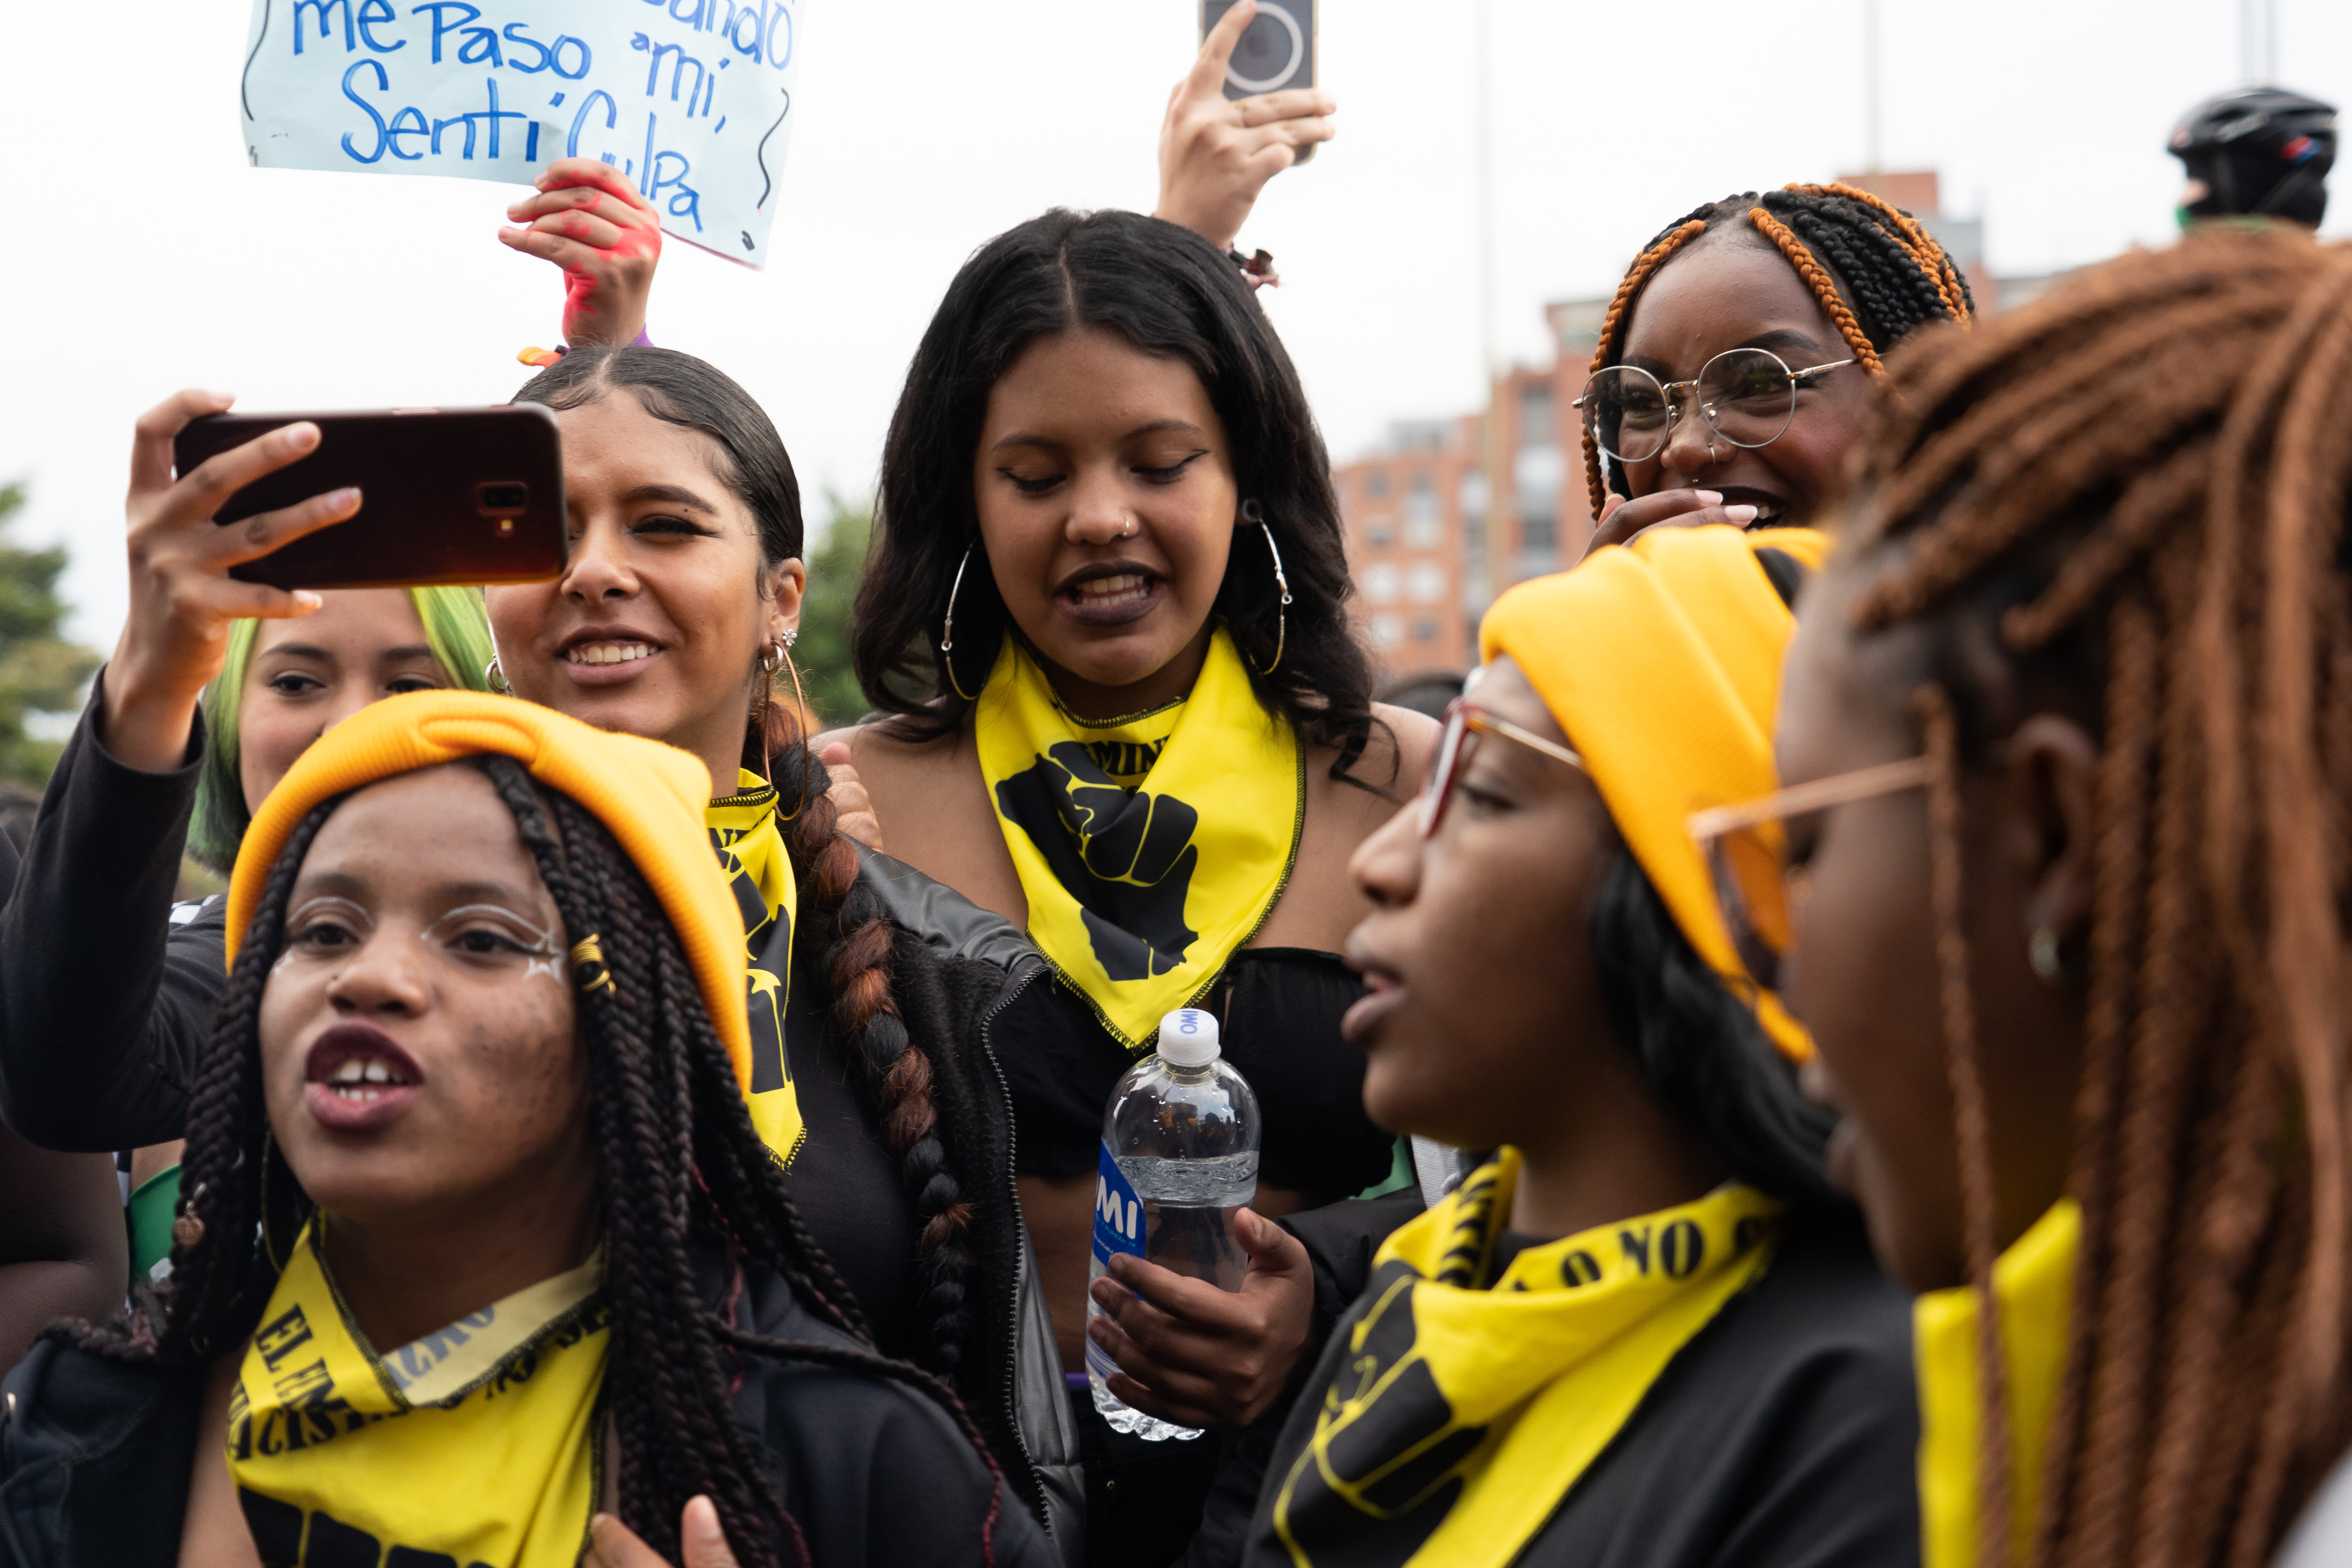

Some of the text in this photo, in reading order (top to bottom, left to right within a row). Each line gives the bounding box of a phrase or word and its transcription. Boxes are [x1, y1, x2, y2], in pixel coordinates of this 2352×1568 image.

[294, 0, 407, 56] me
[412, 1, 592, 80] Paso
[643, 0, 792, 70] ando
[1180, 1011, 1198, 1034] OMI
[1620, 1218, 1704, 1279] NO
[255, 1303, 313, 1373] EL
